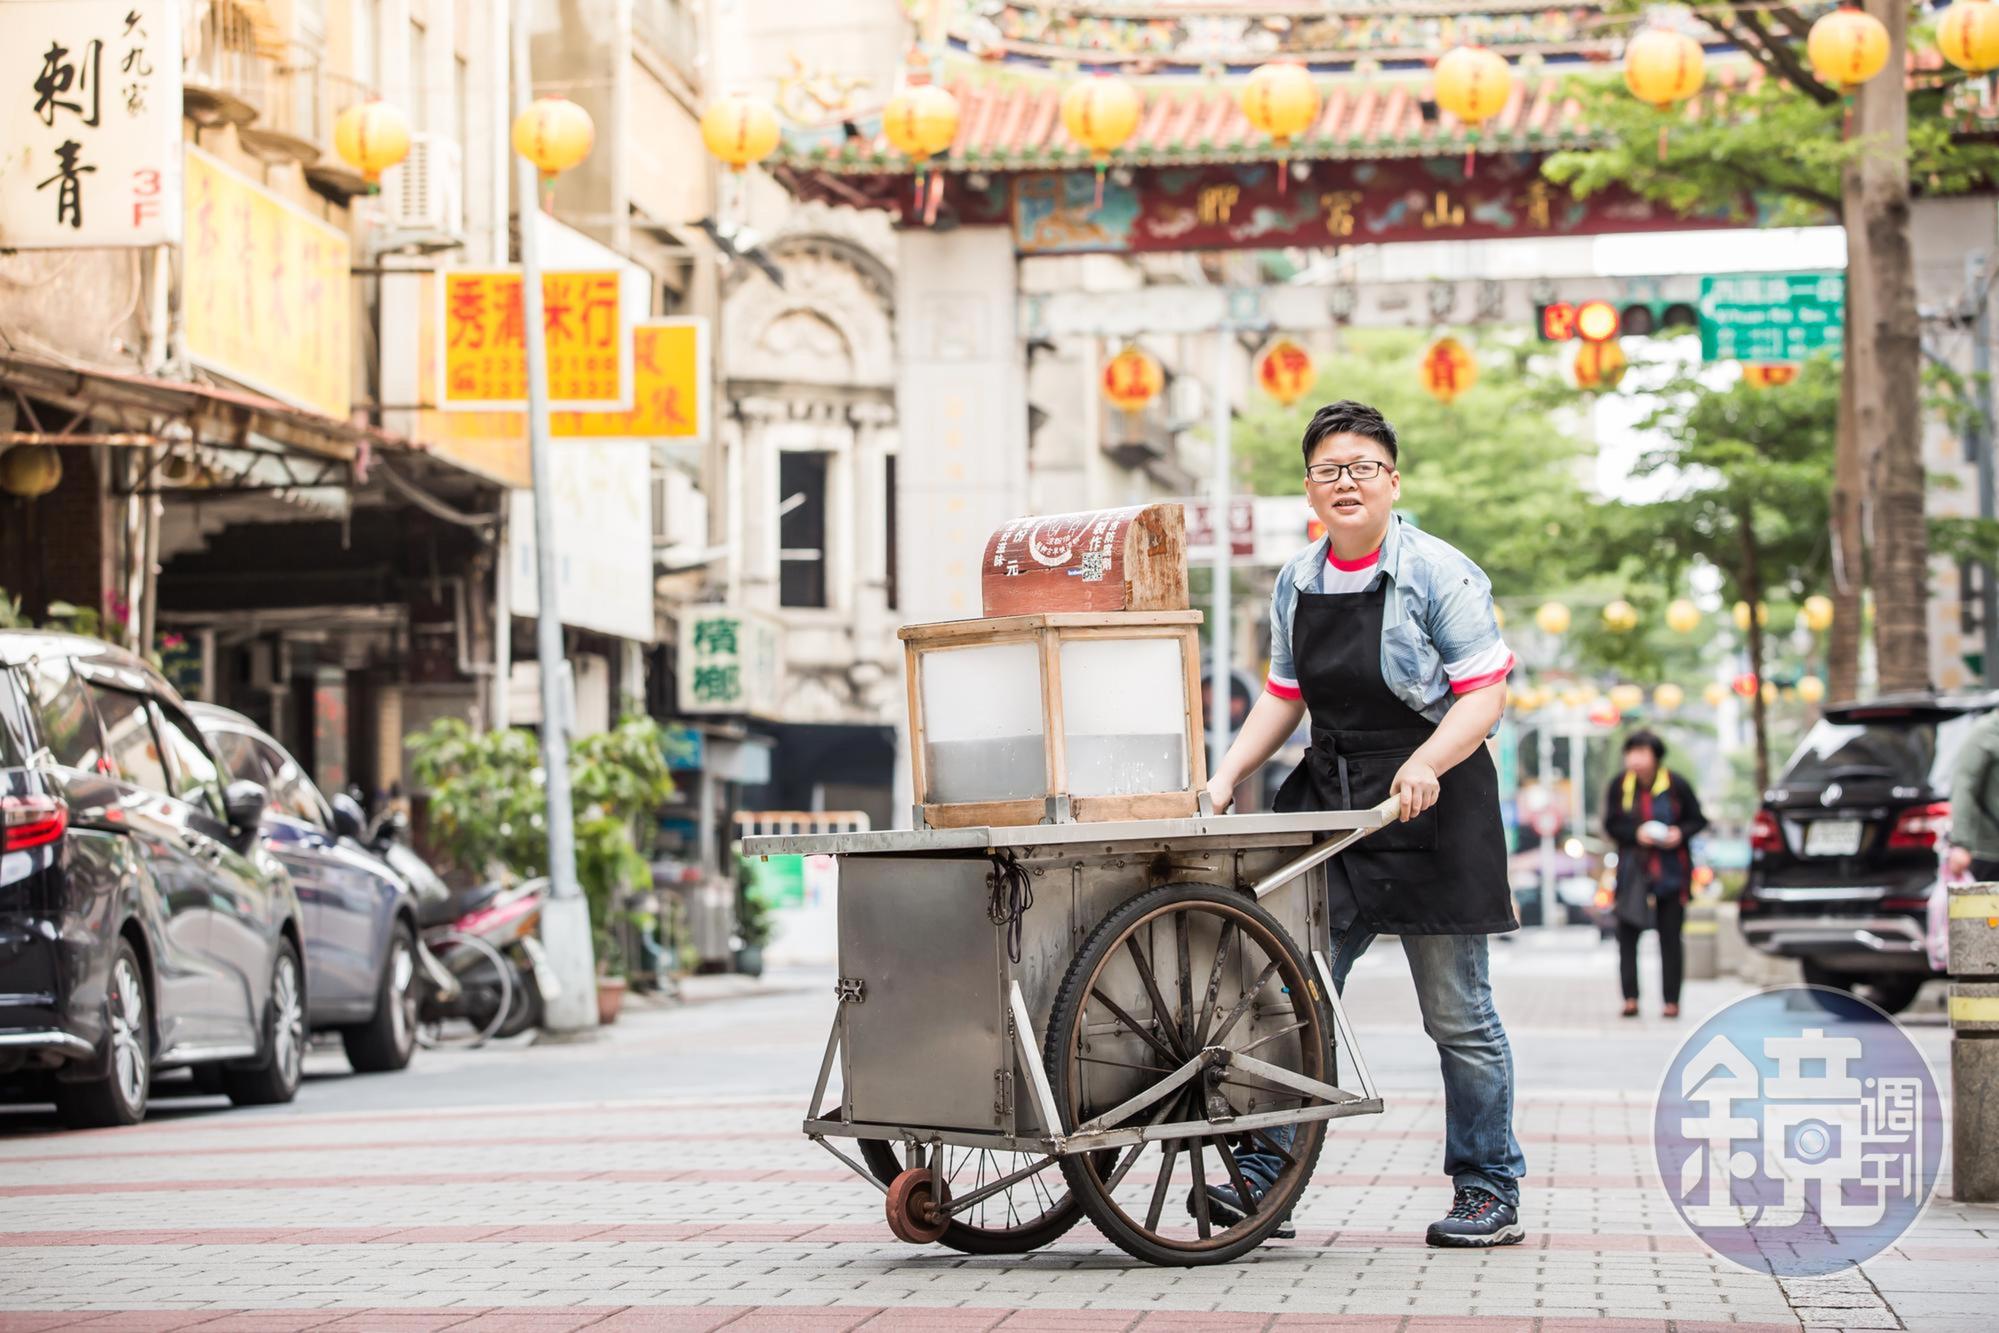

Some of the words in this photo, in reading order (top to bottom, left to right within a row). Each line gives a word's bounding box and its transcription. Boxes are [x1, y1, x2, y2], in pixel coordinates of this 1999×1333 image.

[33, 38, 104, 229] 刺青
[132, 169, 162, 228] 3F
[691, 619, 743, 703] 檳榔
